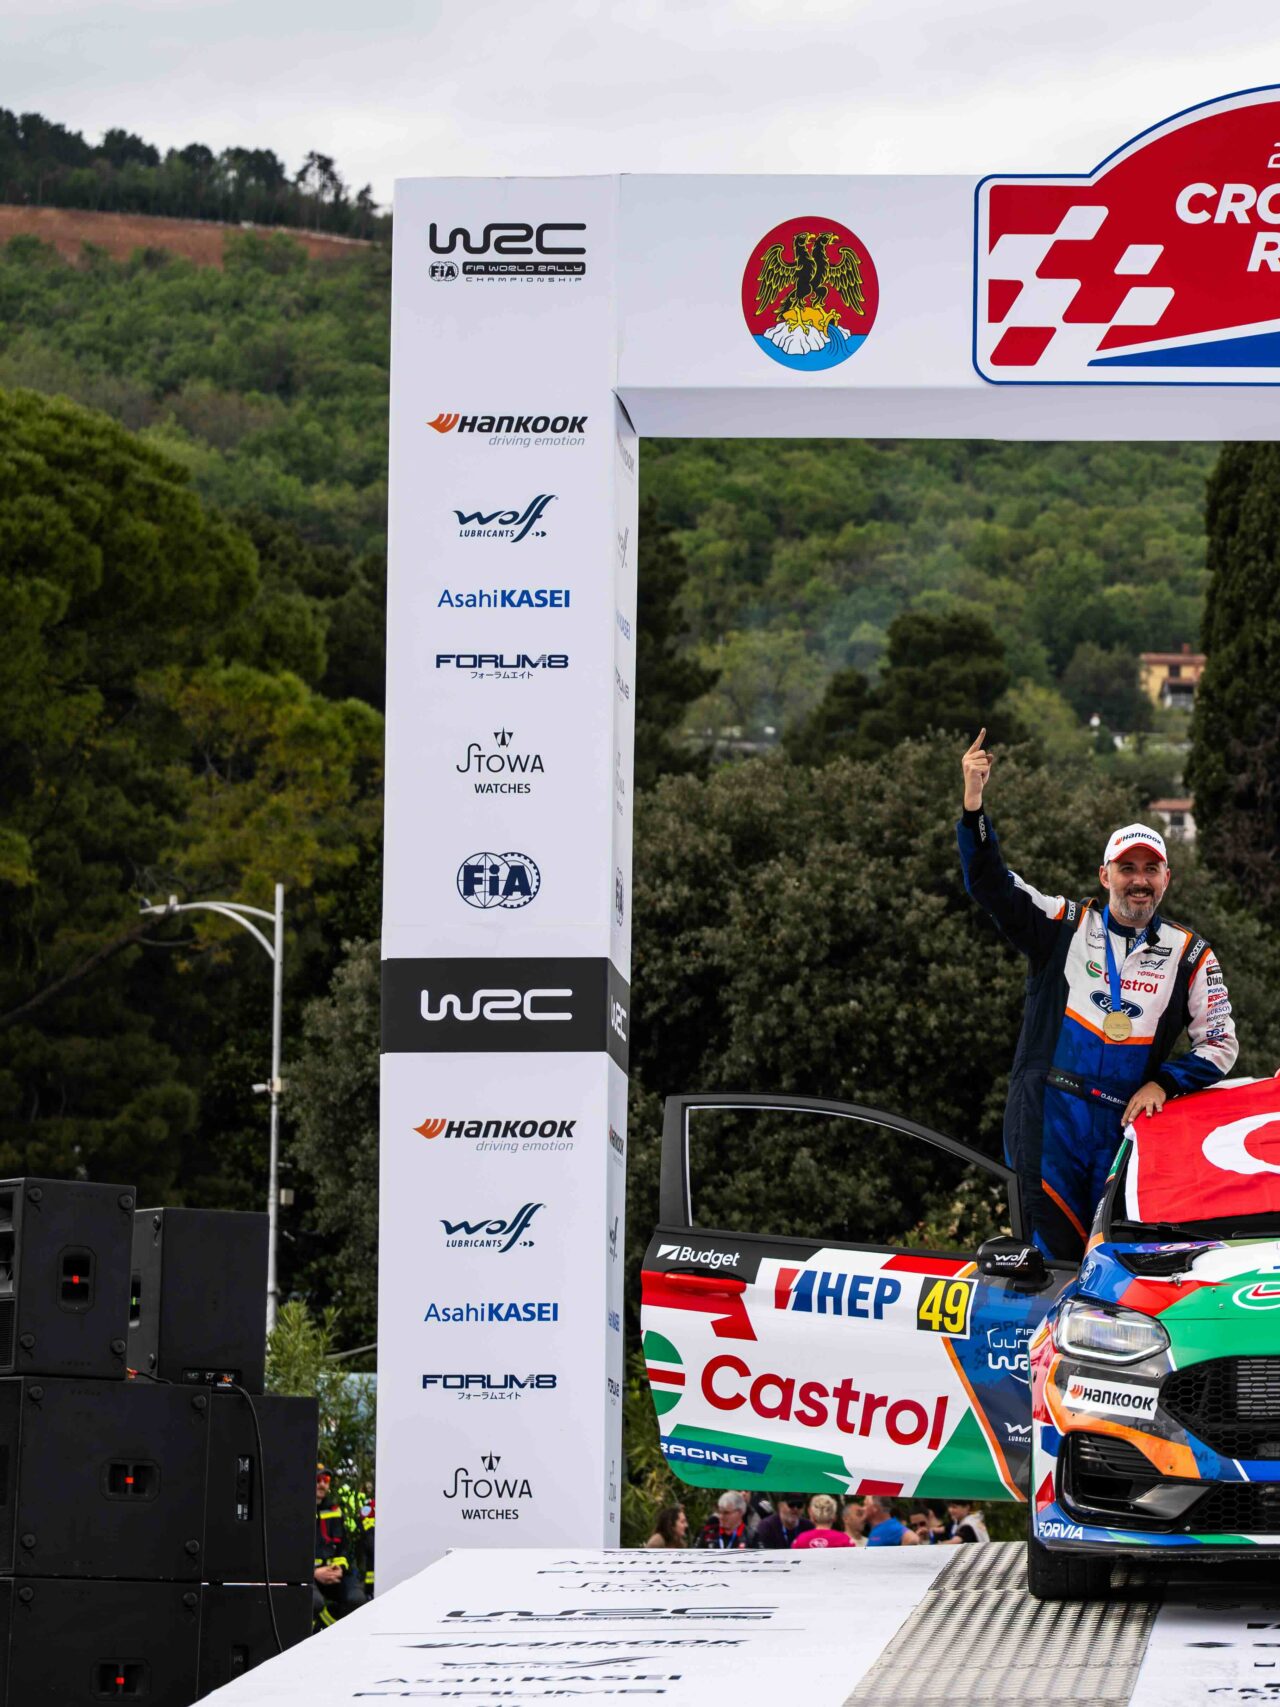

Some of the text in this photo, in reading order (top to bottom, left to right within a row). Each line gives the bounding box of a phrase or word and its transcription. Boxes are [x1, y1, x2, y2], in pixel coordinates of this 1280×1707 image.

[429, 223, 587, 255] WRC
[465, 264, 583, 273] FIA WORLD RALLY
[489, 434, 585, 448] driving emotion
[459, 529, 515, 538] LUBRICANTS
[435, 654, 569, 669] FORUM8
[470, 670, 534, 679] フォーラムエイト
[474, 783, 531, 794] WATCHES
[421, 989, 573, 1021] WRC
[476, 1139, 573, 1153] driving emotion
[446, 1239, 502, 1248] LUBRICANTS
[679, 1246, 740, 1267] Budget
[817, 1271, 901, 1320] HEP
[919, 1279, 970, 1333] 49
[422, 1374, 557, 1389] FORUM8
[457, 1391, 522, 1401] フォーラムエイト
[700, 1353, 949, 1451] Castrol
[461, 1509, 519, 1520] WATCHES
[1039, 1522, 1084, 1540] FORVIA
